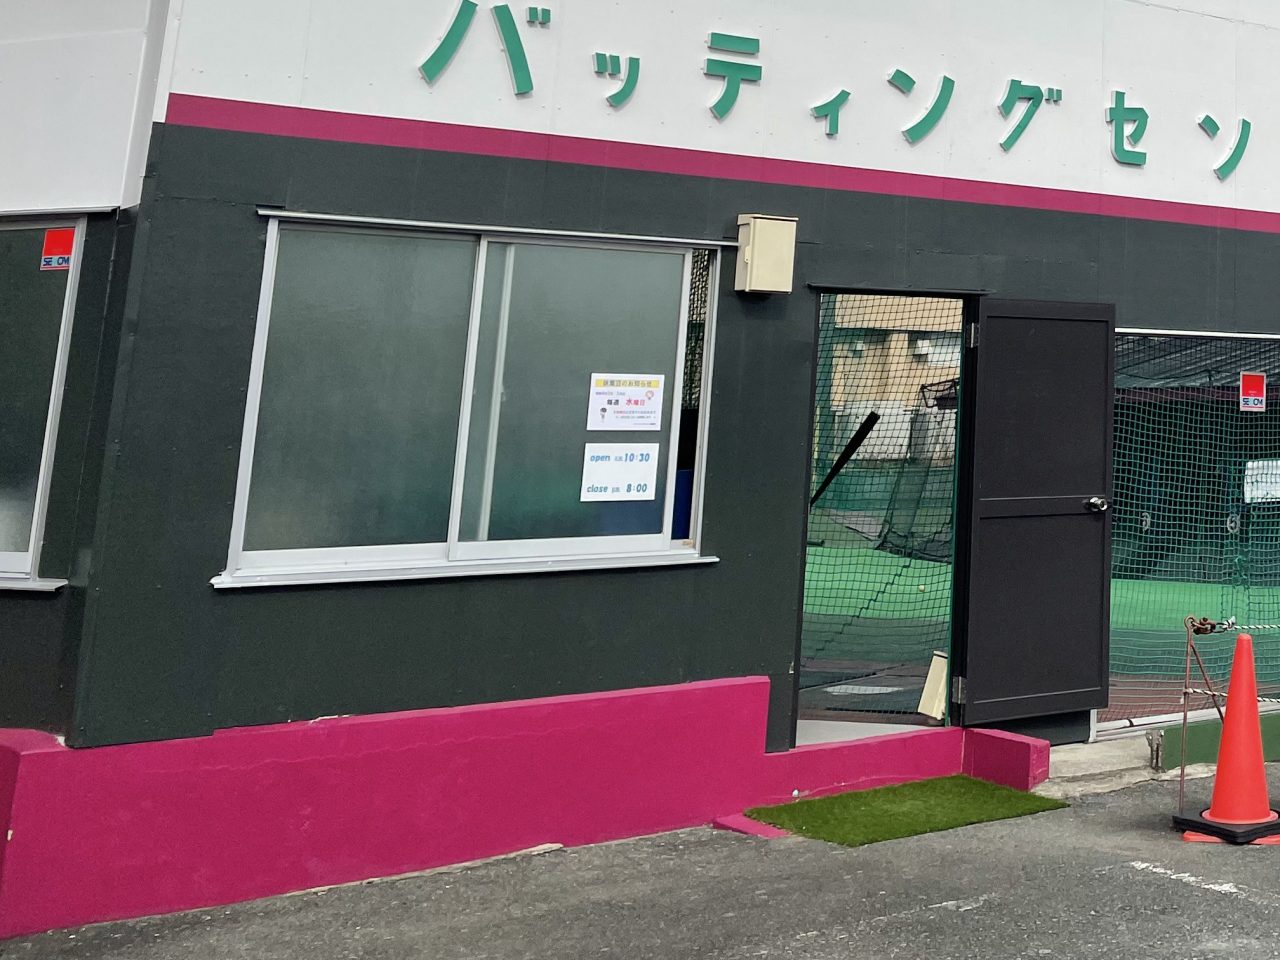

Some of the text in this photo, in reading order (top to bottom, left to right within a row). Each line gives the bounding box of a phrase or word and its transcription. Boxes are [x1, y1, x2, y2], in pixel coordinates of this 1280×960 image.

[626, 398, 645, 406] 水曜日
[590, 454, 611, 463] open
[624, 453, 650, 463] 10:30
[587, 484, 609, 493] close
[626, 483, 648, 493] 8:00
